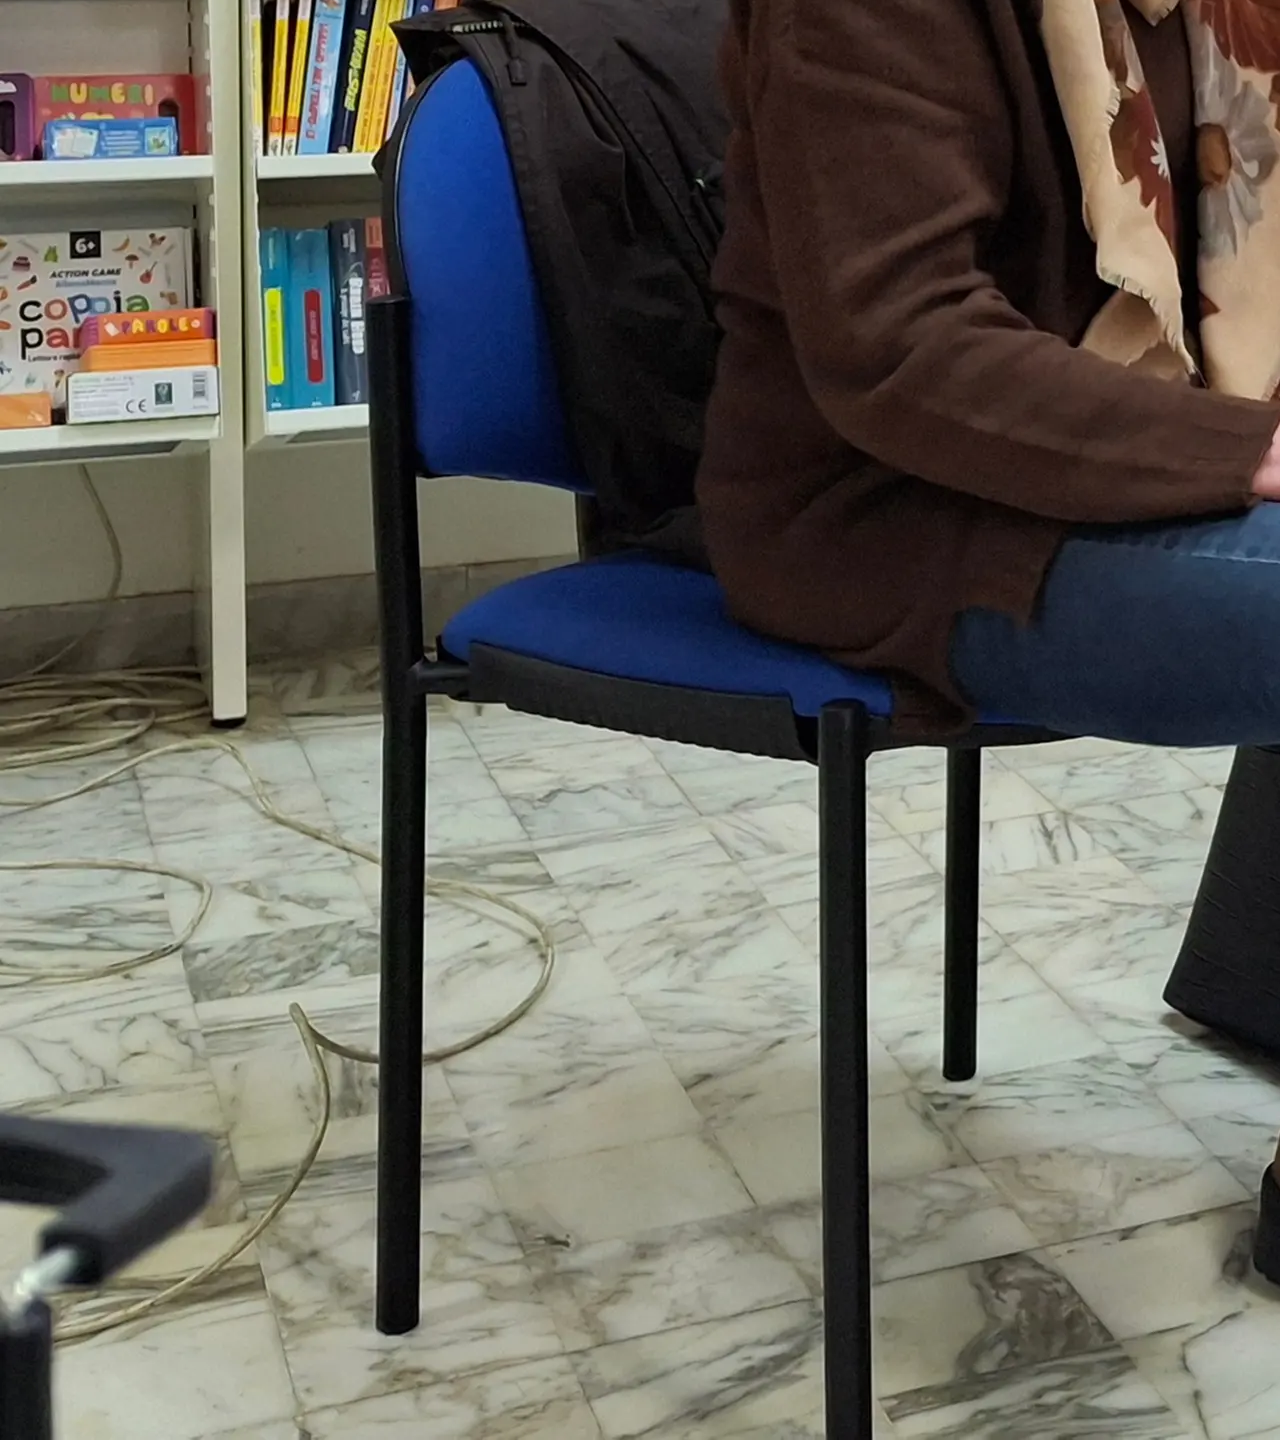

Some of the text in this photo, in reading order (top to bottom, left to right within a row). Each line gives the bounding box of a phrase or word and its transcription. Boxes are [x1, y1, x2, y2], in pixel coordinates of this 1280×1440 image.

[51, 82, 154, 106] NUMERI
[75, 237, 97, 253] 6+
[50, 267, 121, 279] ACTION GAME
[121, 316, 189, 338] PAROLE
